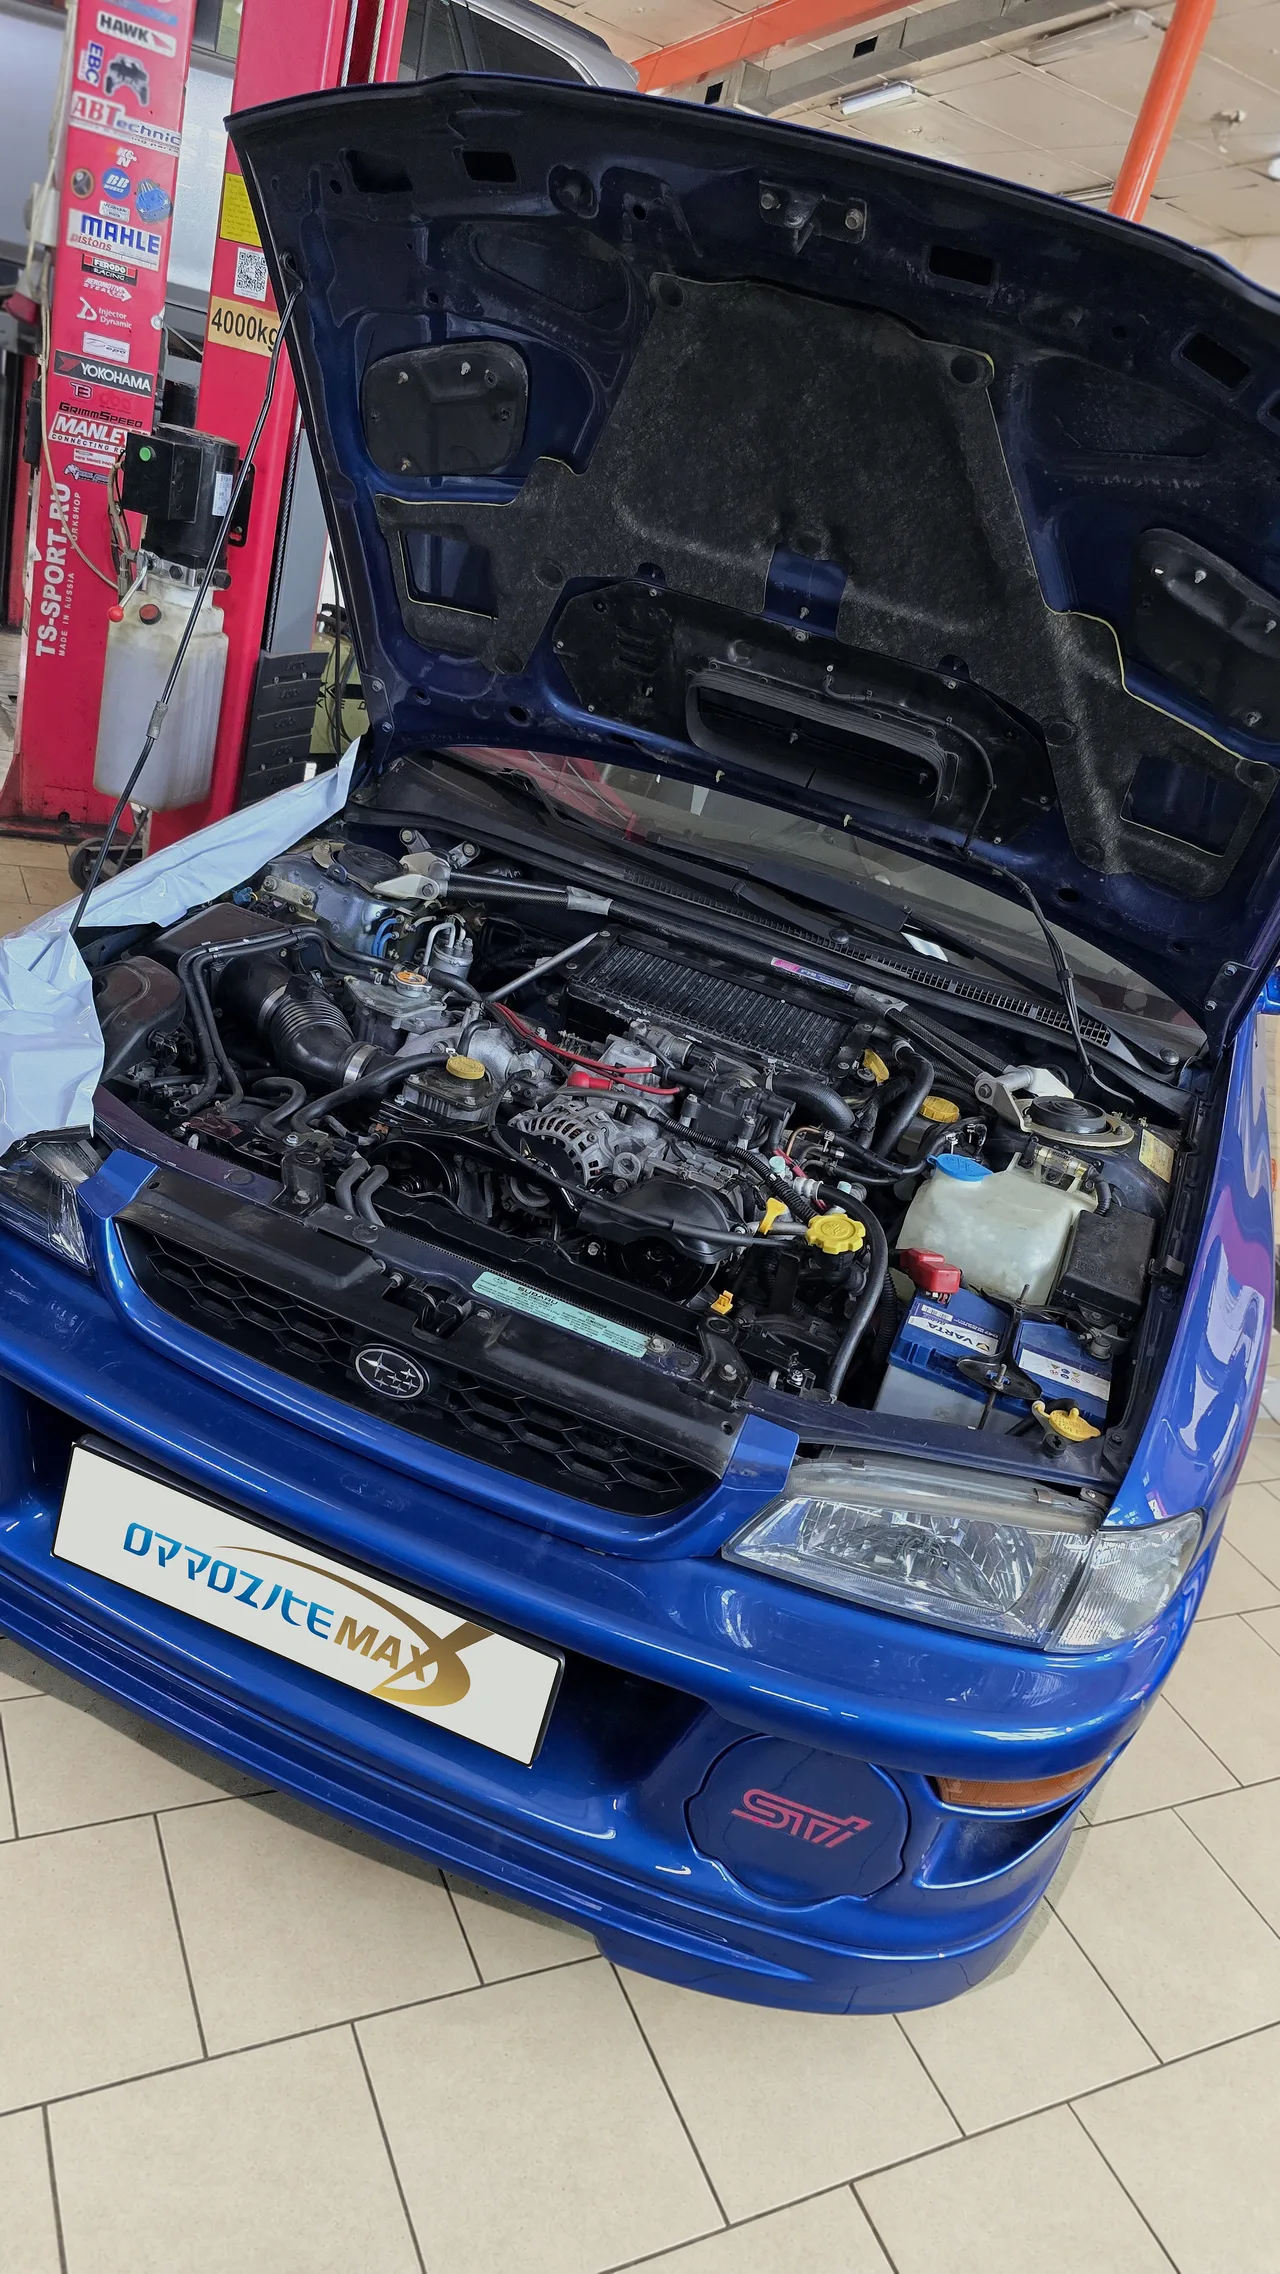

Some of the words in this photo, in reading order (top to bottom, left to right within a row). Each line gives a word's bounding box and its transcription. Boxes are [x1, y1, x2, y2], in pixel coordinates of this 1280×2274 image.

[100, 14, 148, 43] HAWK
[85, 42, 103, 85] EBC
[69, 232, 112, 251] pistons
[81, 214, 160, 255] MAHLE
[93, 268, 125, 281] RACING
[94, 258, 126, 274] FERODO
[98, 307, 127, 320] Injector
[100, 316, 132, 329] Dynamic
[81, 362, 151, 392] YOKOHAMA
[51, 433, 109, 451] CONNECTING
[62, 615, 70, 625] IN
[58, 631, 68, 657] MADE
[517, 1285, 558, 1305] SUBARU
[927, 1321, 973, 1346] VARTA
